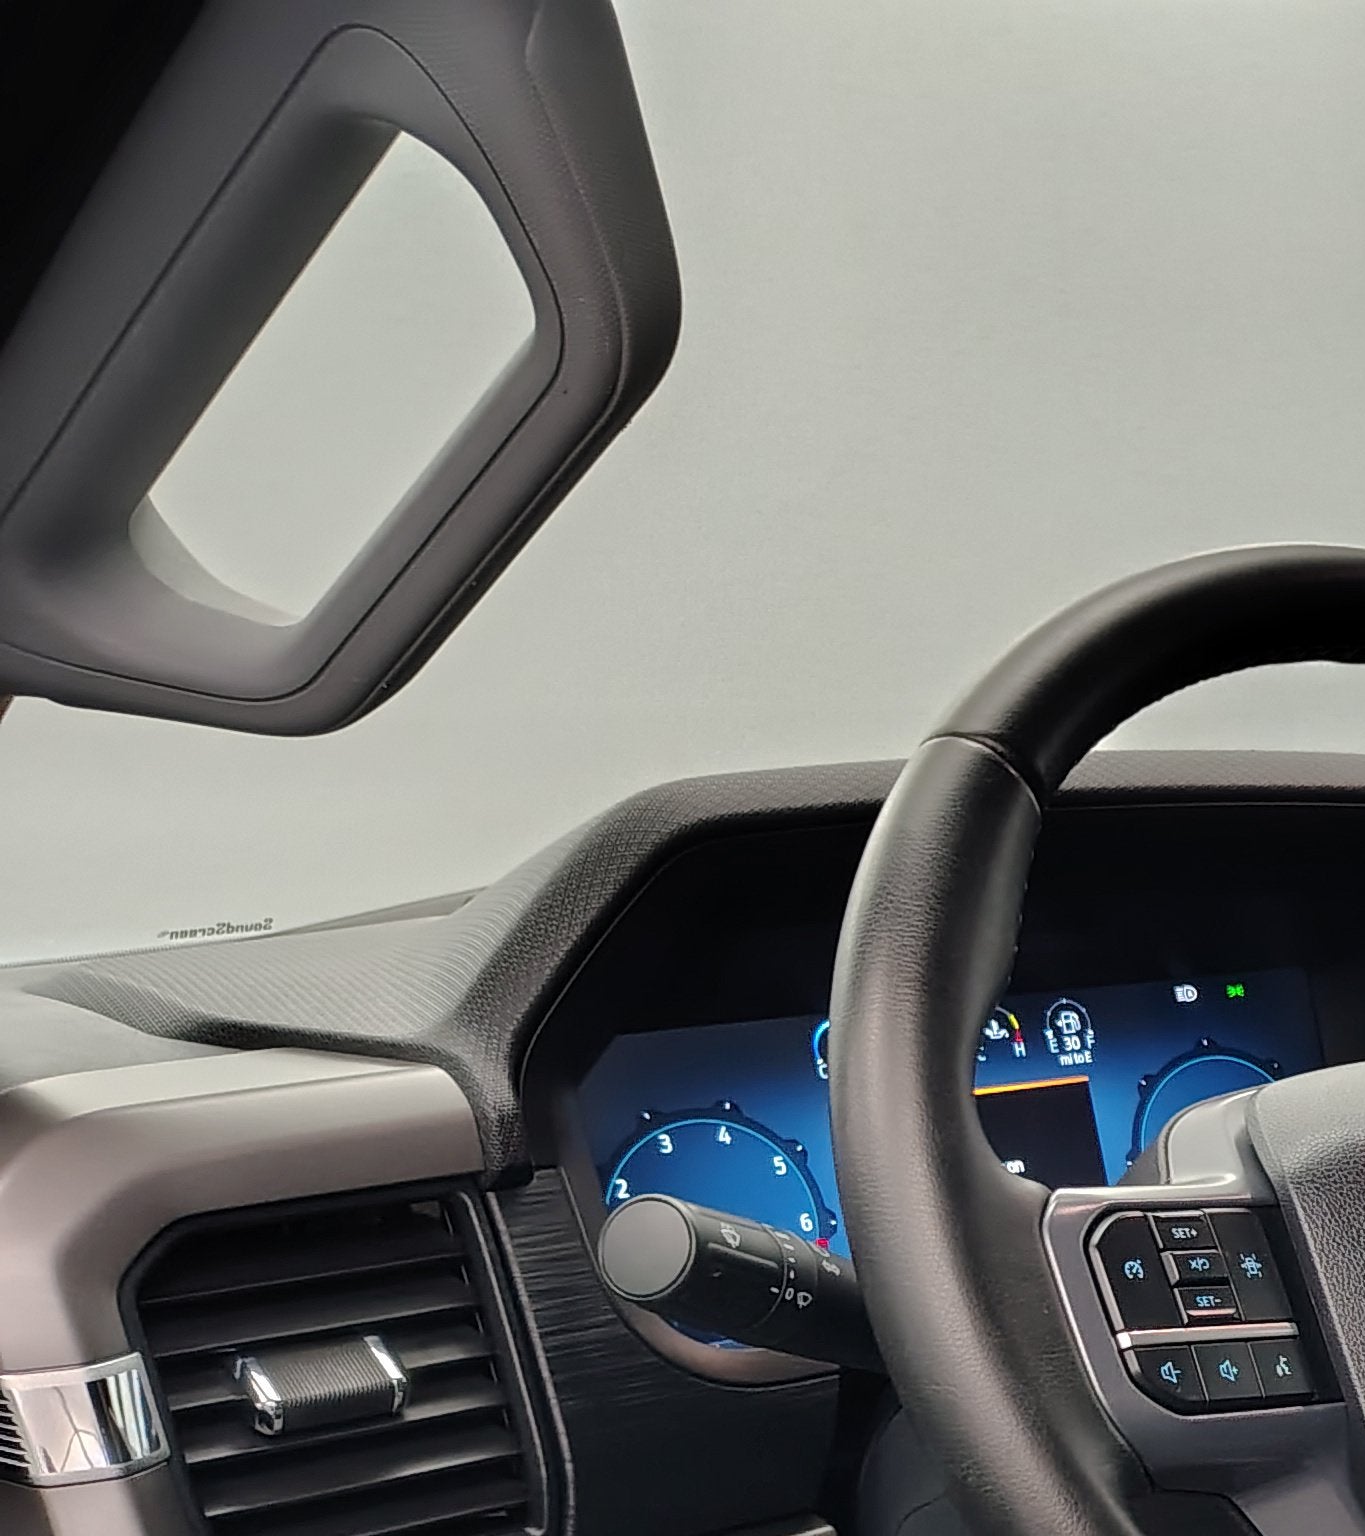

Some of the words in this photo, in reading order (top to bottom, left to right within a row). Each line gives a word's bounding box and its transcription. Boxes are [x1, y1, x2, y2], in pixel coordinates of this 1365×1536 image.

[1013, 1041, 1028, 1058] H
[1063, 1036, 1082, 1052] 30
[657, 1133, 674, 1155] 3
[718, 1125, 732, 1146] 4
[772, 1156, 788, 1176] 5
[614, 1177, 631, 1200] 2
[799, 1212, 814, 1233] 6
